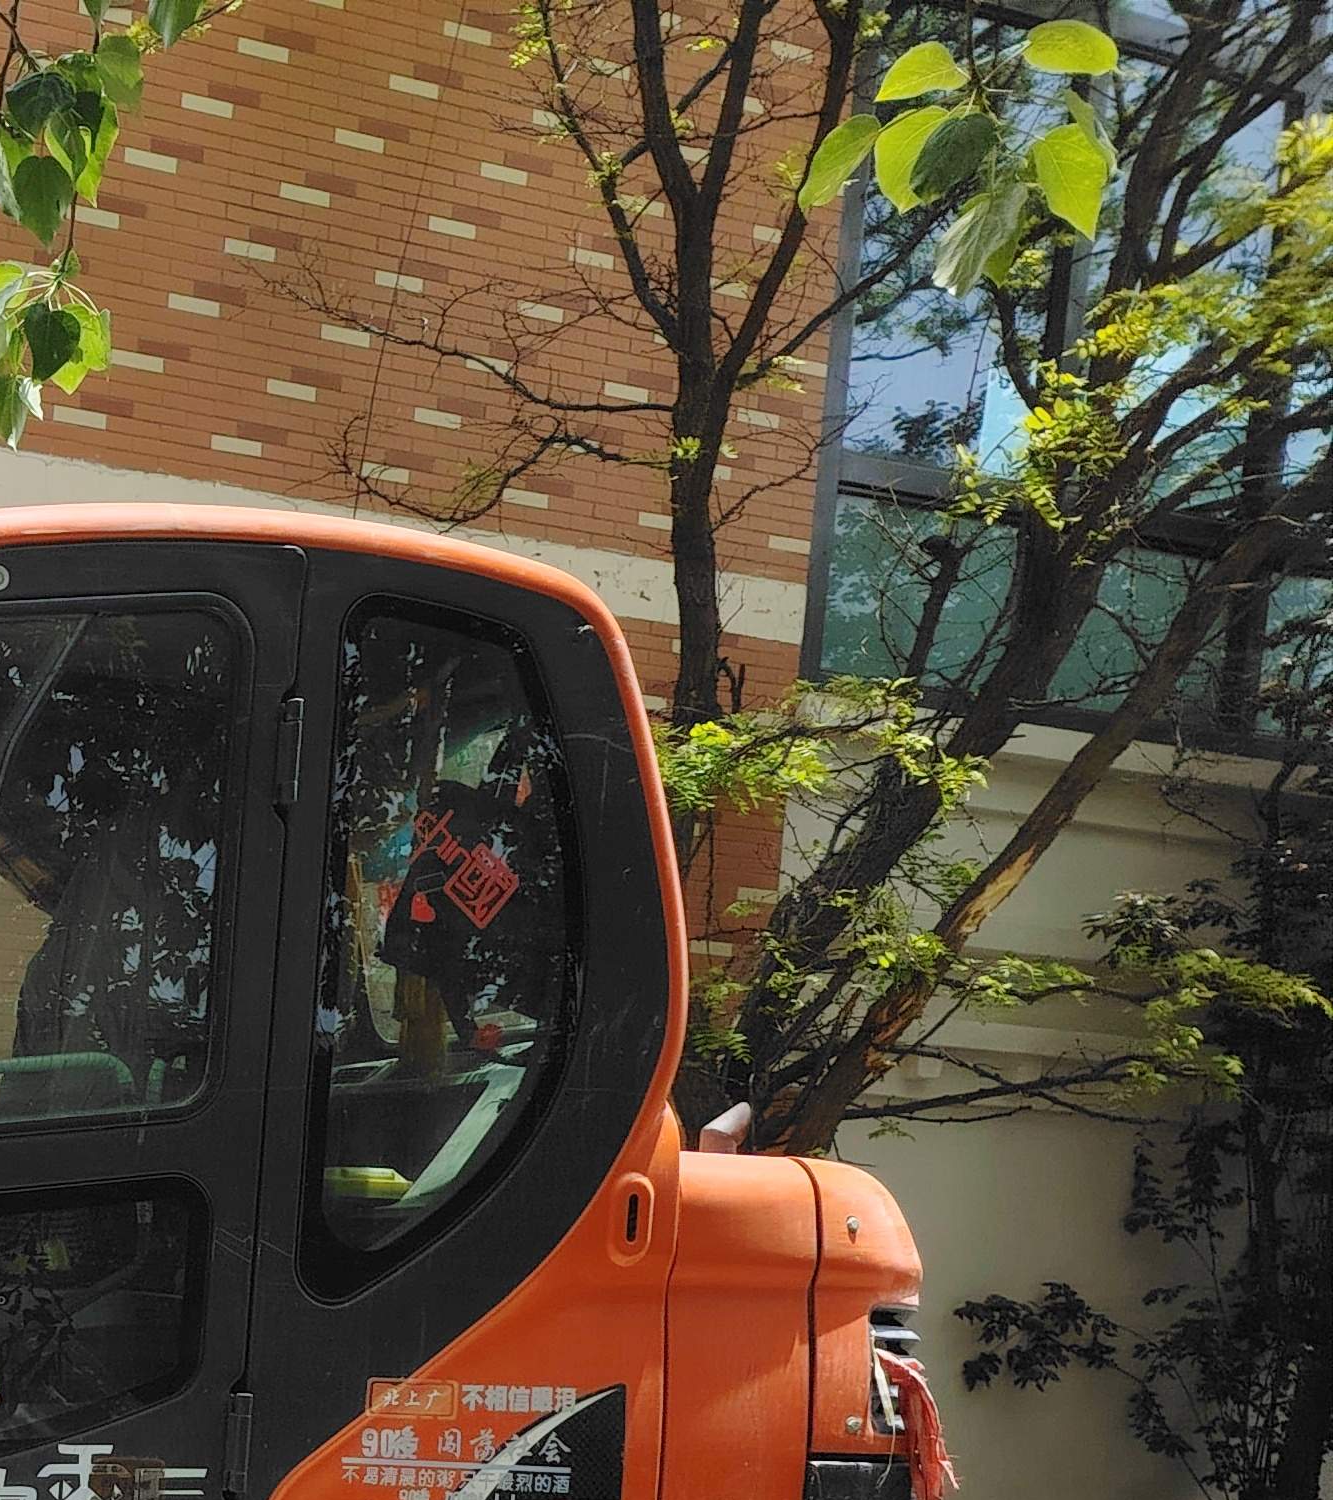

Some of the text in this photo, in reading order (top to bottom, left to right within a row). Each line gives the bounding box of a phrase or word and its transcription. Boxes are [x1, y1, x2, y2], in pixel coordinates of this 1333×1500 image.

[461, 1384, 577, 1414] 不相信眼泪
